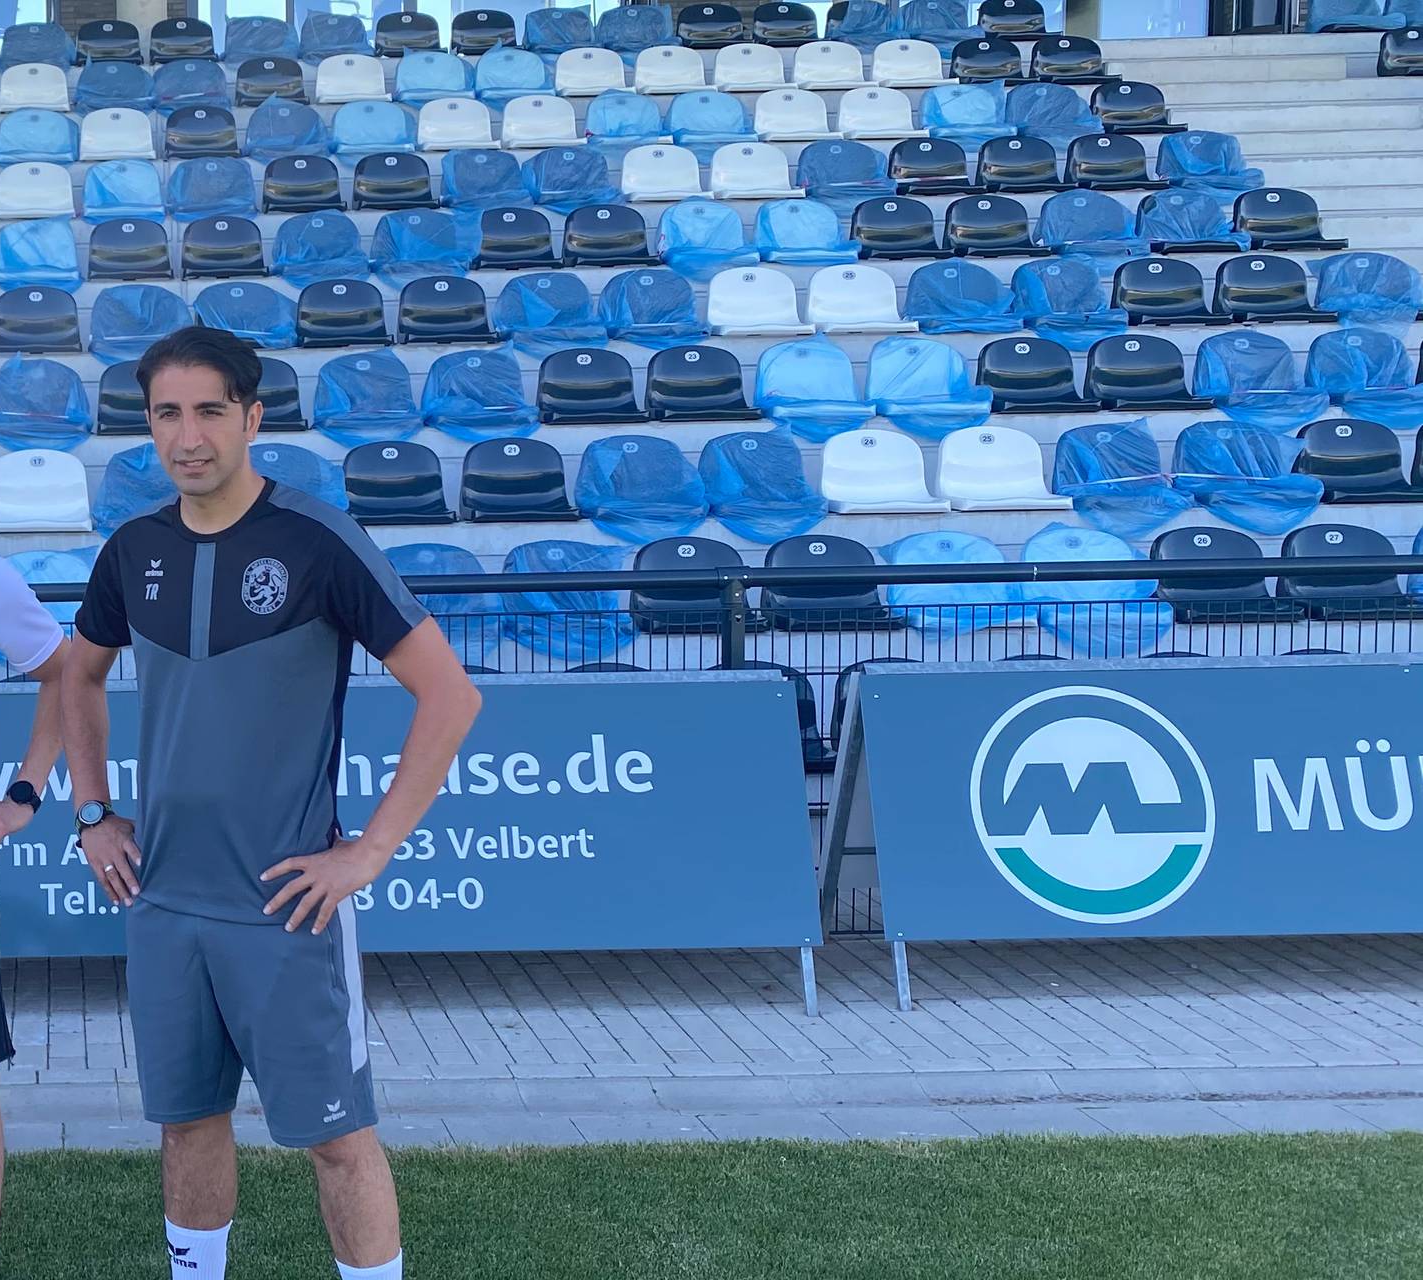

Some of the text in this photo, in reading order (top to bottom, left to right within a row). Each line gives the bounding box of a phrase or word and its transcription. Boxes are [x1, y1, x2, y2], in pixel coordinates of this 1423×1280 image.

[145, 583, 159, 601] TR
[1254, 739, 1423, 832] MÜ
[446, 825, 596, 861] Velbert
[388, 877, 484, 912] 04-0
